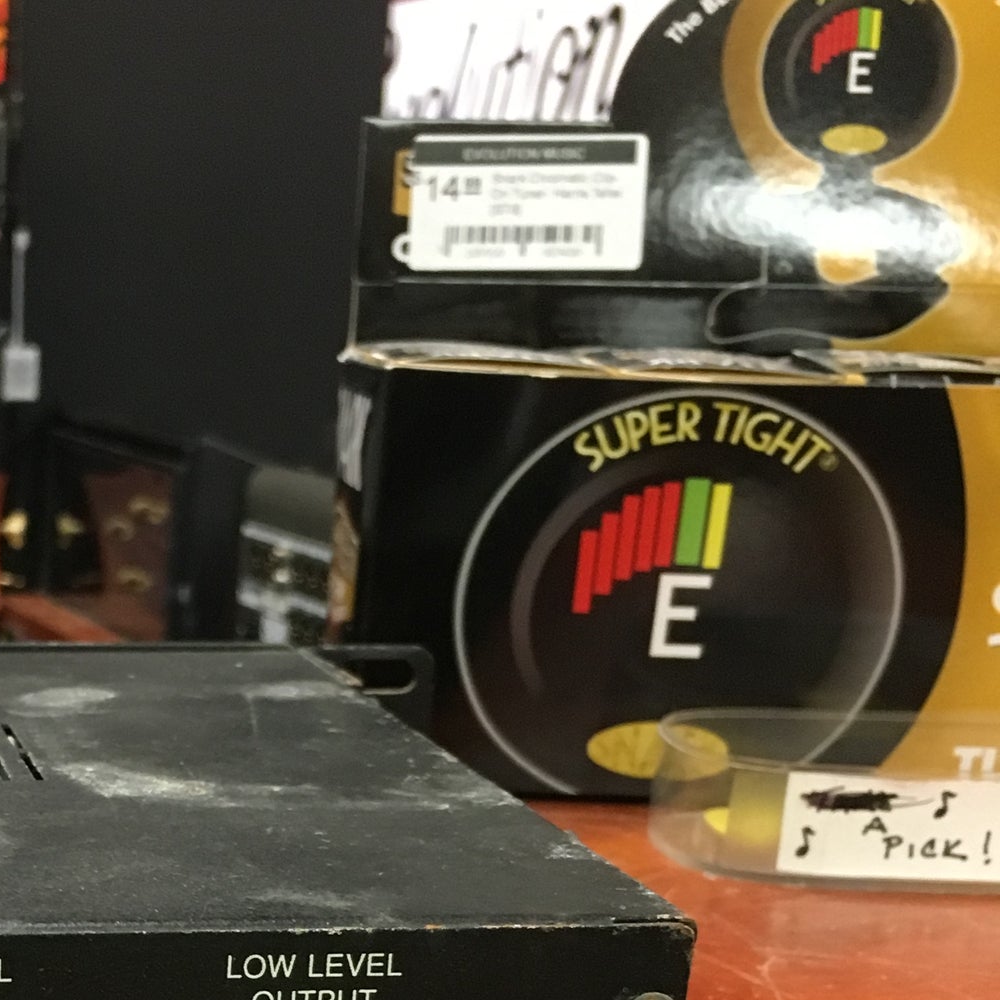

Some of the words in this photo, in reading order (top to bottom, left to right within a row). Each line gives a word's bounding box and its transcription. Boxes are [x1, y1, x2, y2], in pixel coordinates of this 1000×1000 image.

[846, 51, 877, 94] E
[573, 401, 701, 472] SUPER
[649, 572, 713, 659] E
[862, 816, 888, 835] A
[226, 954, 297, 979] LOW
[308, 953, 403, 978] LEVEL
